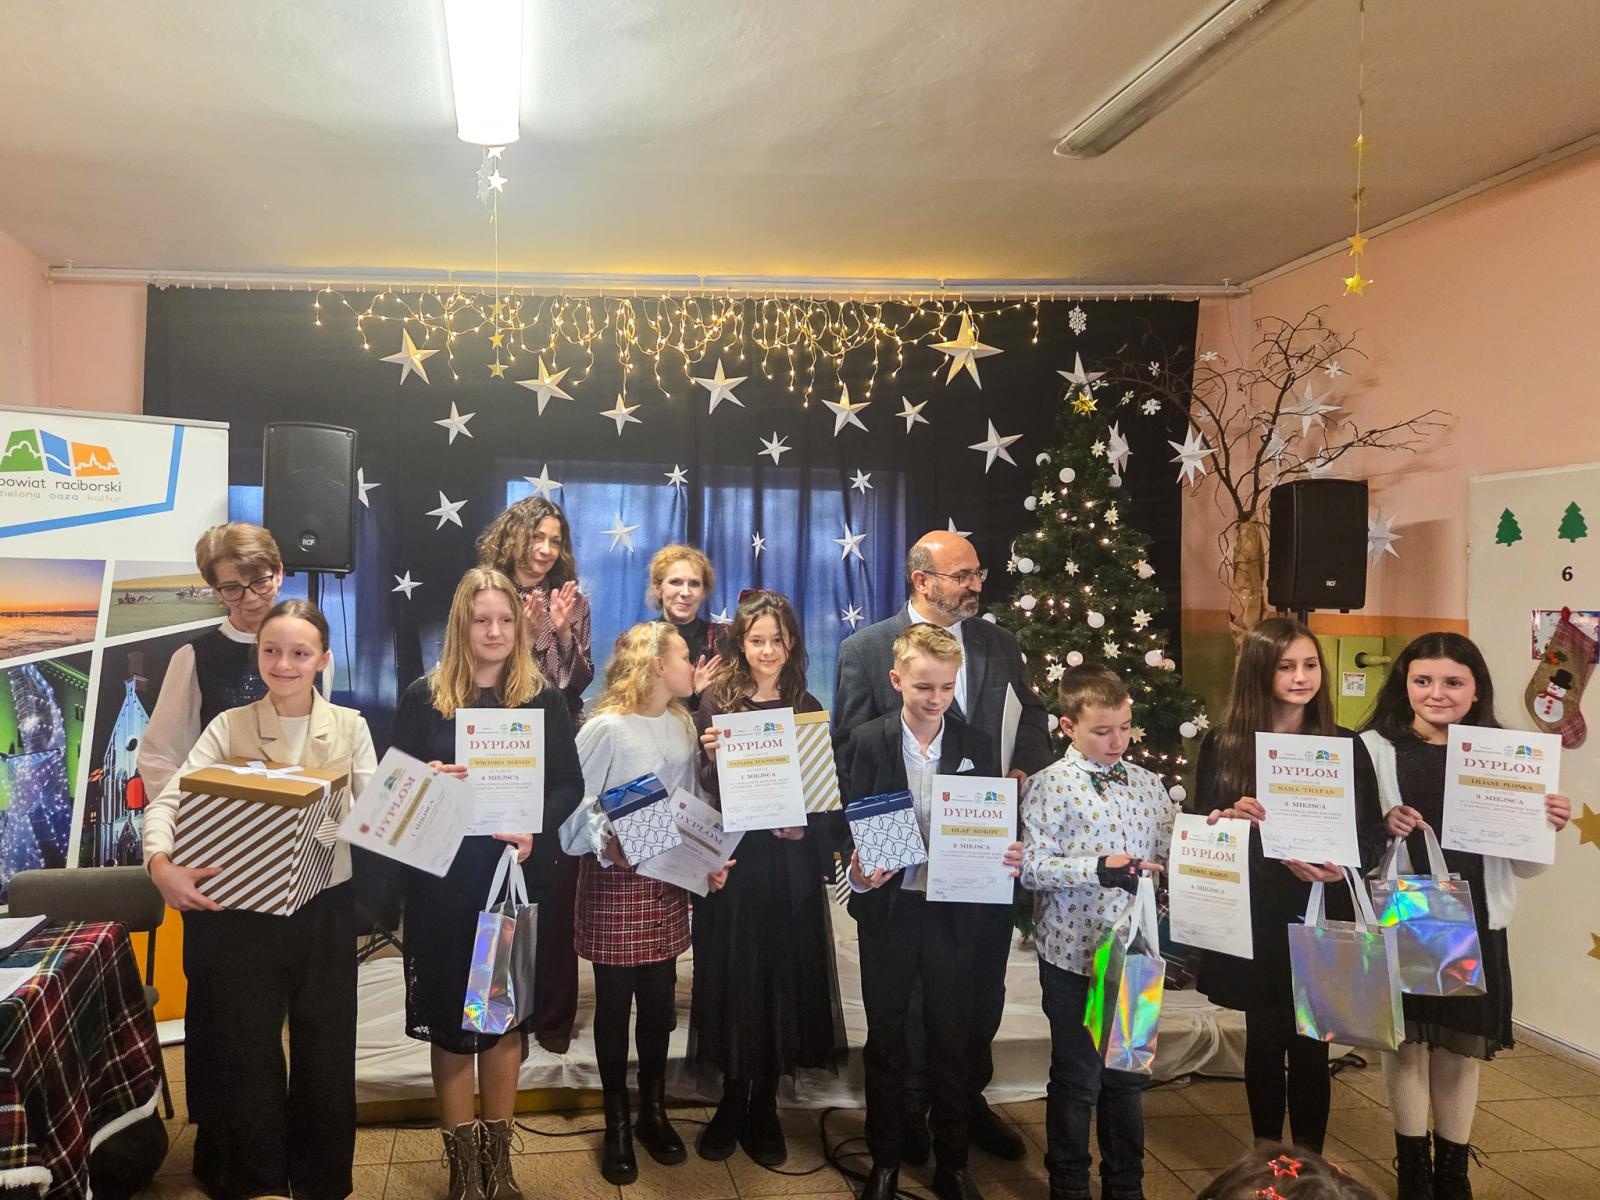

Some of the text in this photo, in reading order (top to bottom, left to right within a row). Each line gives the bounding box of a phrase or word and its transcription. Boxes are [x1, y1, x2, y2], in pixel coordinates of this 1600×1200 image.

[55, 480, 122, 492] raciborski
[49, 492, 79, 501] oaza
[302, 538, 315, 546] RCF
[1562, 566, 1573, 581] 6
[470, 740, 531, 750] DYPLOM
[727, 739, 784, 752] DYPLOM
[1272, 765, 1338, 779] DYPLOM
[1464, 758, 1541, 775] DYPLOM
[1485, 794, 1525, 805] MIEJSCA
[375, 776, 416, 838] DYPLOM
[943, 807, 1003, 819] DYPLOM
[676, 811, 723, 845] DYPLOM
[1181, 846, 1236, 863] DYPLOM
